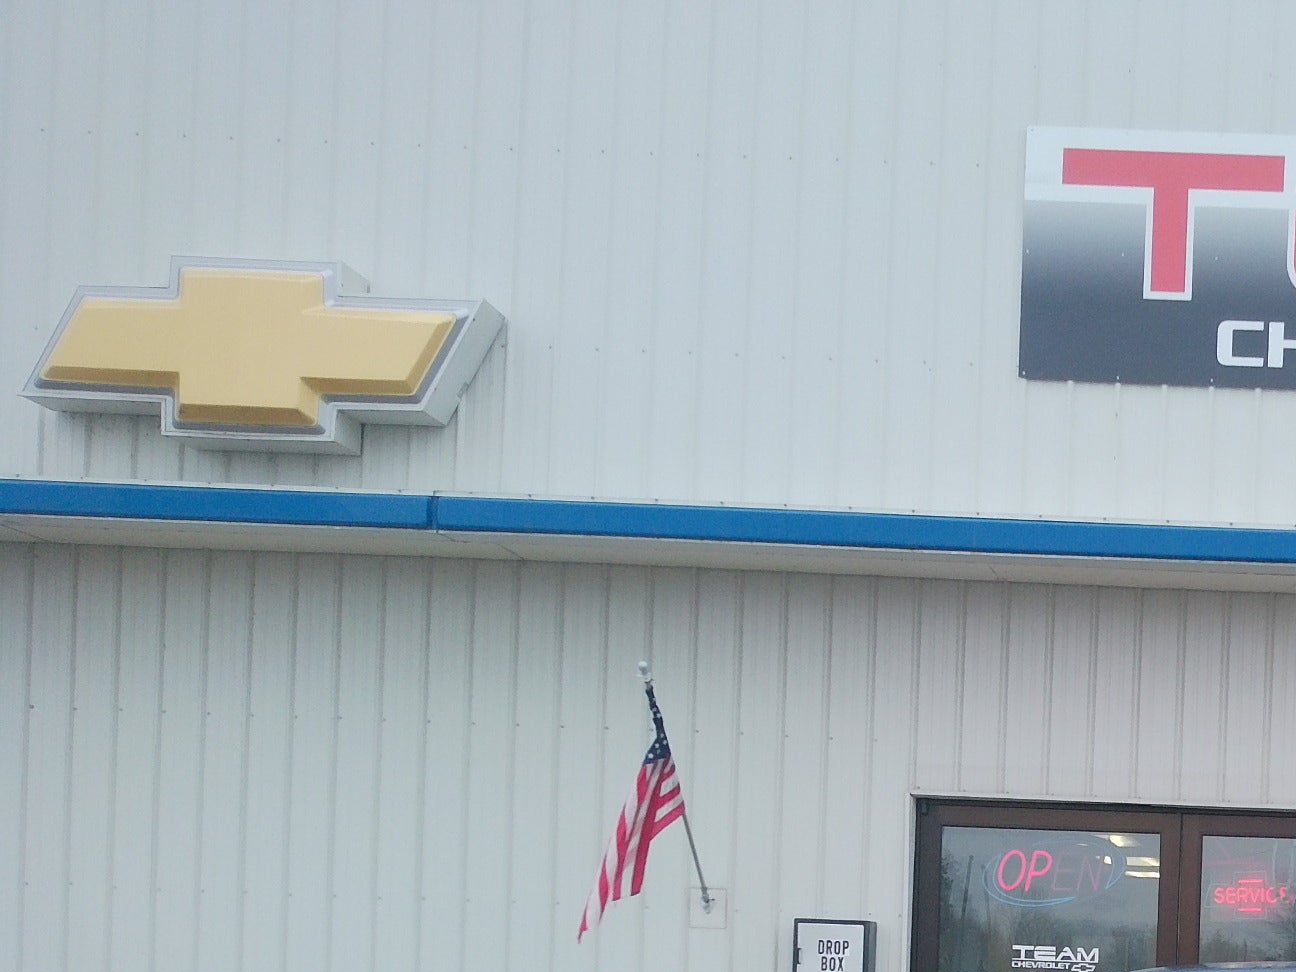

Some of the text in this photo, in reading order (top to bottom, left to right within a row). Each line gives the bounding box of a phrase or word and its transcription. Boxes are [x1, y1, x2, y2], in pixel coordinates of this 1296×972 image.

[997, 849, 1104, 892] OPEN
[818, 939, 850, 955] DROP
[1012, 944, 1100, 963] TEAM
[820, 956, 844, 972] BOX
[1011, 961, 1071, 970] CHEVROLET
